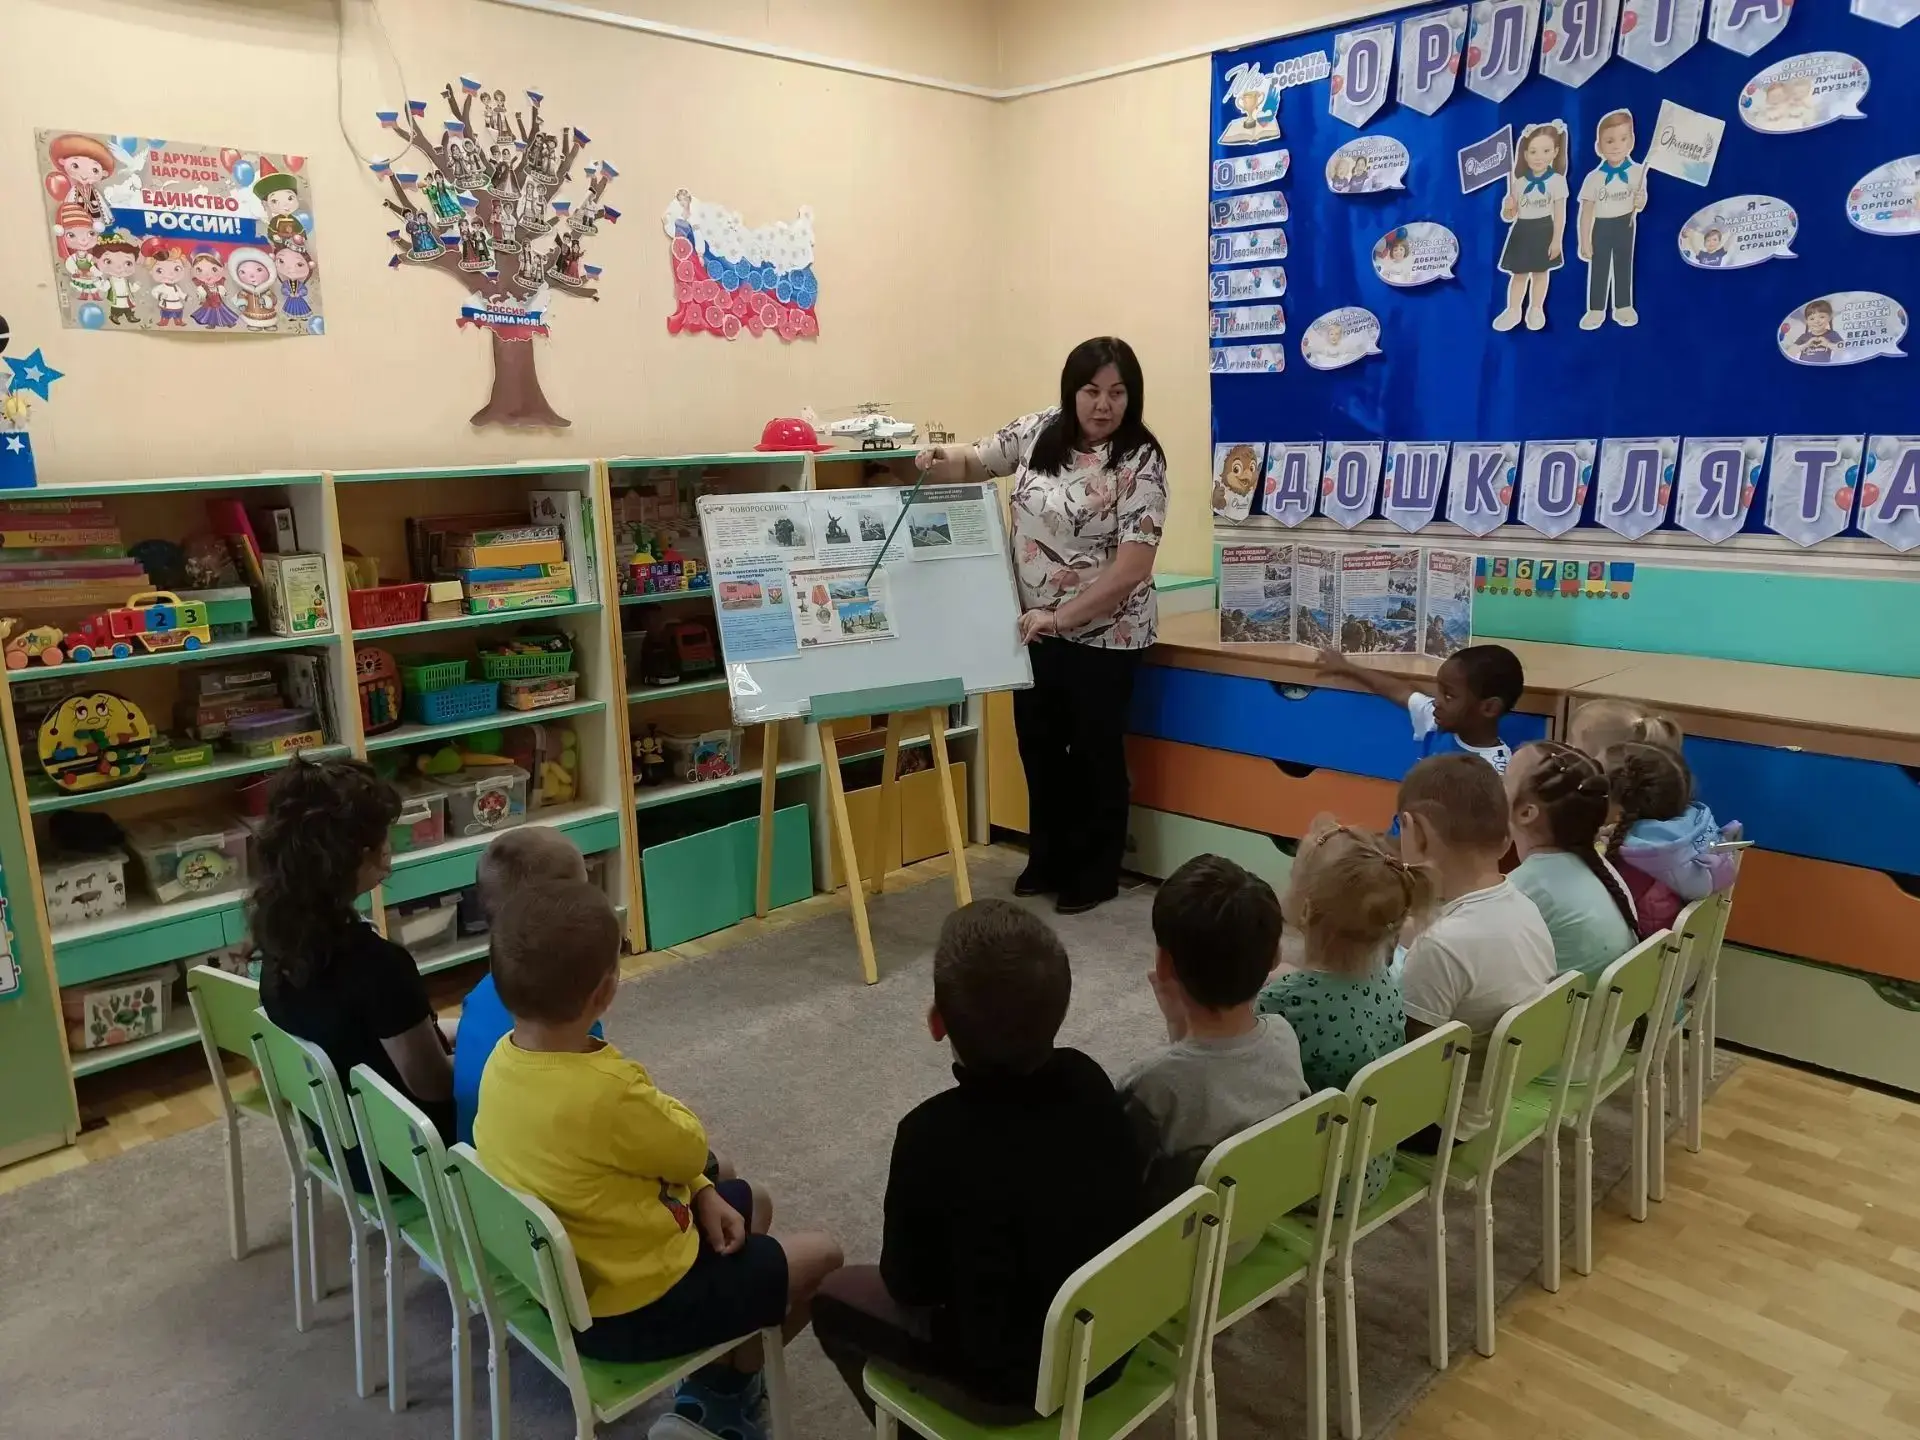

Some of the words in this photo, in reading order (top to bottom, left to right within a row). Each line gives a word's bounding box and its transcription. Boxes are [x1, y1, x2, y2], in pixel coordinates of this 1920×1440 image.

[1815, 70, 1863, 84] ЛУЧШИЕ
[150, 150, 159, 162] В
[163, 153, 218, 168] ДРУЖБЕ
[1368, 153, 1405, 163] ДРУЖНЫЕ
[142, 190, 239, 212] ЕДИНСТВО
[1747, 201, 1756, 211] Я
[144, 211, 242, 235] РОССИИ!
[1737, 227, 1789, 242] БОЛЬШОЙ
[1740, 239, 1785, 251] СТРАНЫ!
[473, 313, 515, 324] РОДИНА
[517, 318, 539, 326] МОЯ!
[1847, 329, 1877, 339] ВЕДЬ
[1275, 449, 1920, 522] ДОШКОЛЯТА
[1494, 559, 1507, 578] 5
[1518, 561, 1531, 579] 6
[1541, 562, 1554, 579] 7
[1563, 562, 1577, 580] 8
[1589, 561, 1602, 580] 9
[123, 616, 133, 630] 1
[155, 613, 168, 627] 2
[185, 609, 197, 624] 3
